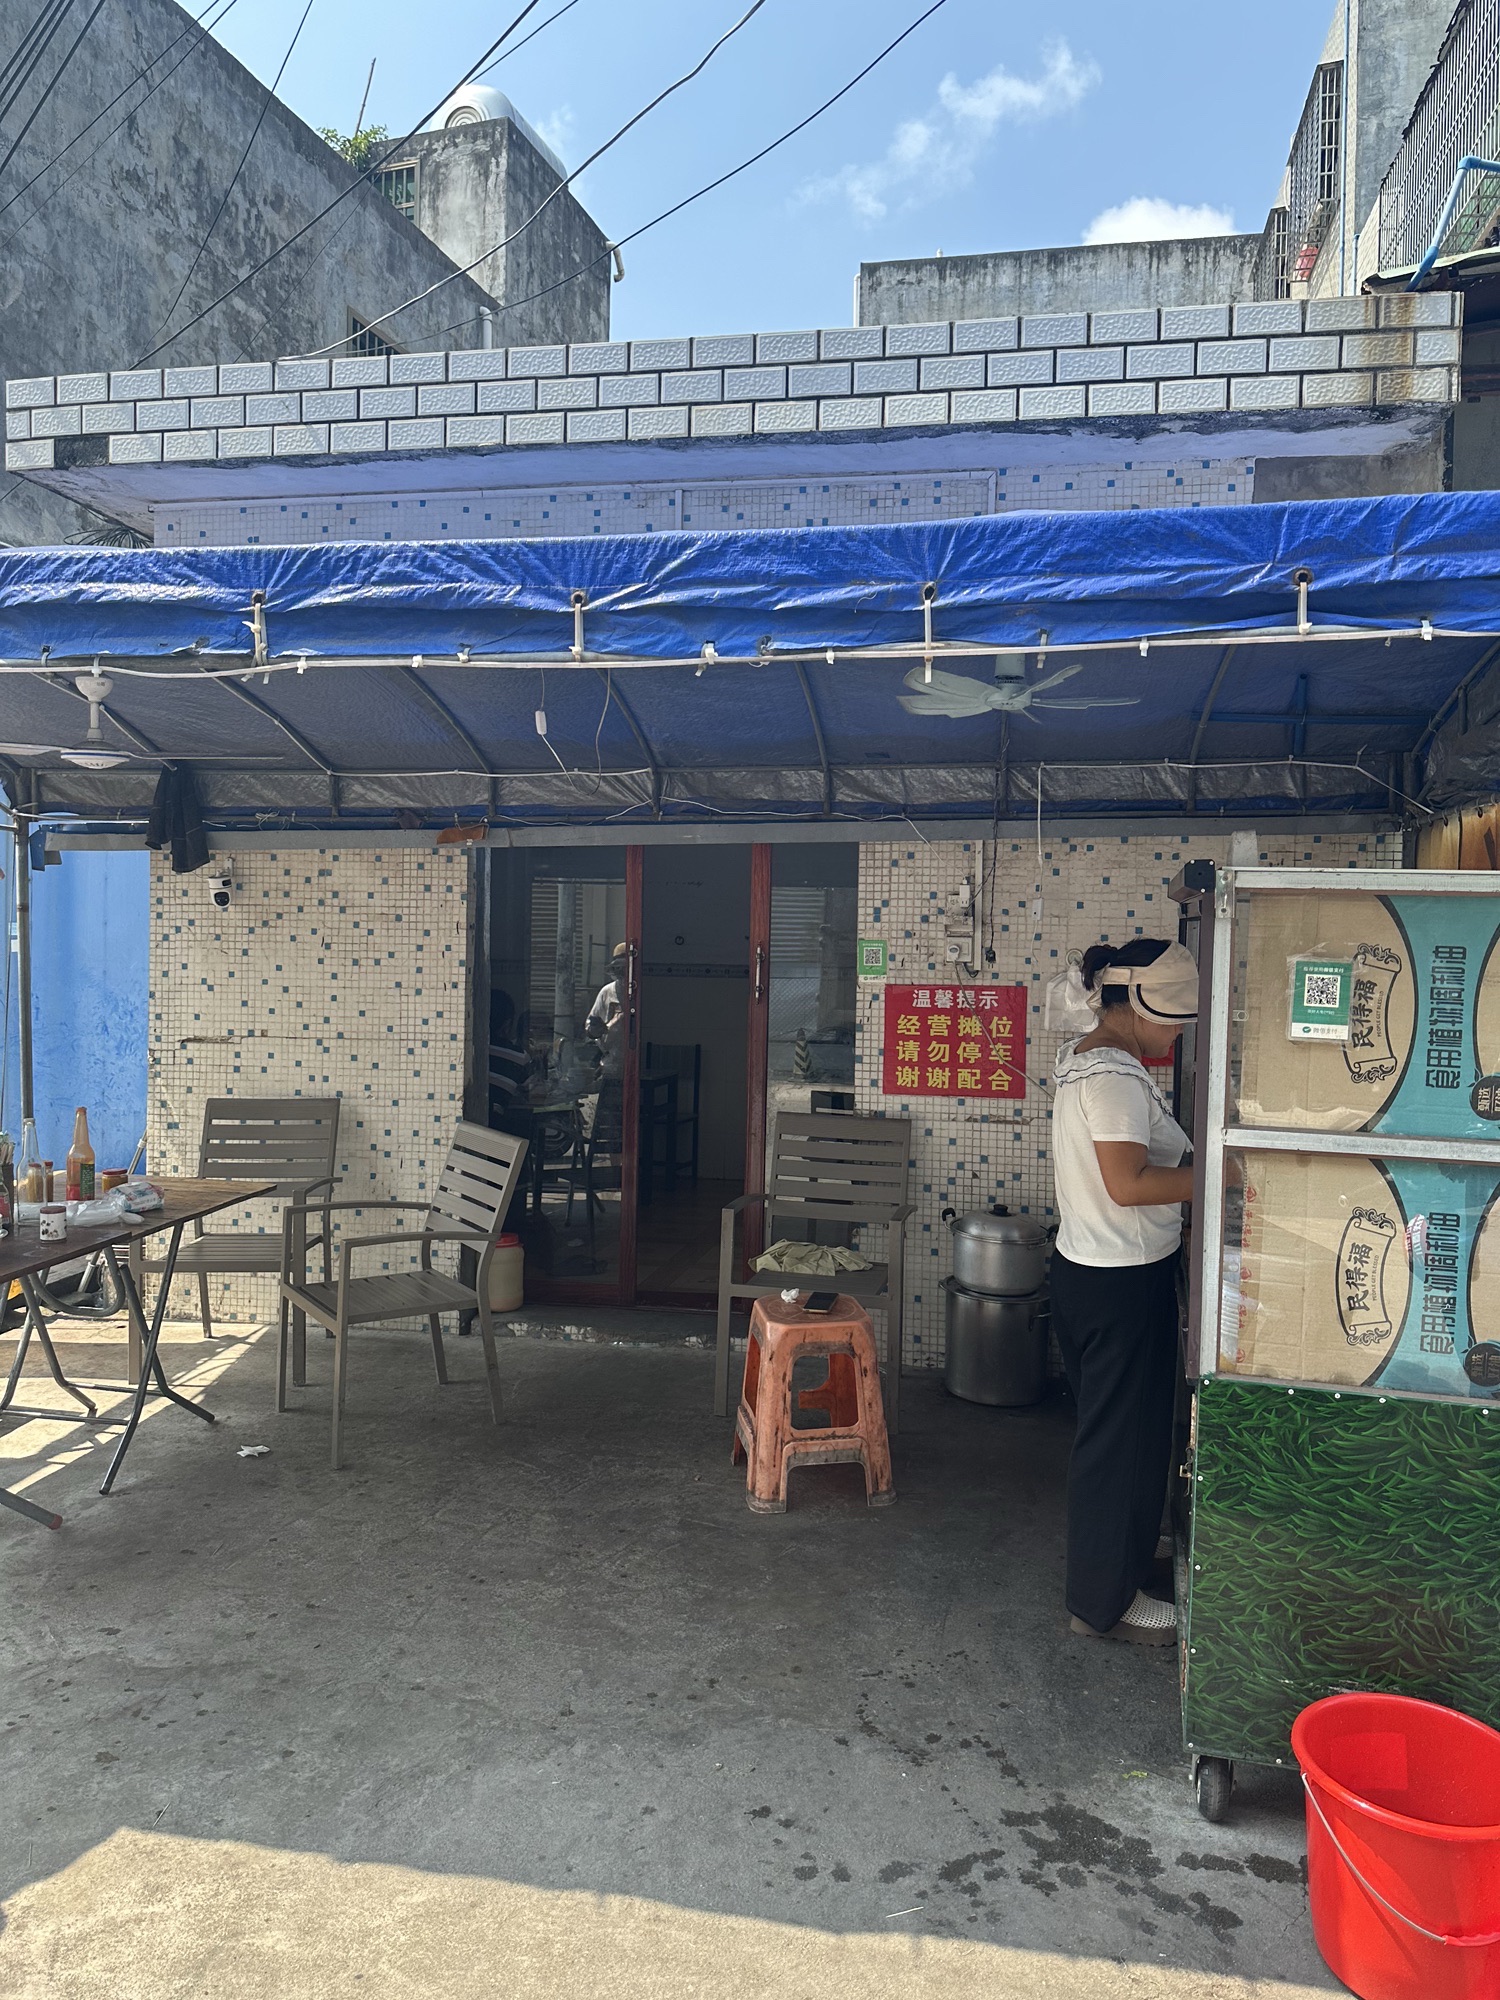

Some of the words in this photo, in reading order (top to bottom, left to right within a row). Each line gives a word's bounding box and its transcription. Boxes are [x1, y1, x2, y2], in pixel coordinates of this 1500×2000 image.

[912, 989, 999, 1010] 温馨提示
[1351, 978, 1378, 1048] 民得福
[1425, 945, 1467, 1089] 食用植物调和油
[896, 1014, 1014, 1038] 经营摊位
[896, 1040, 1013, 1065] 请勿停车
[895, 1066, 1013, 1091] 谢谢配合
[1345, 1242, 1373, 1312] 民得福
[1419, 1212, 1461, 1355] 食用植物调和油
